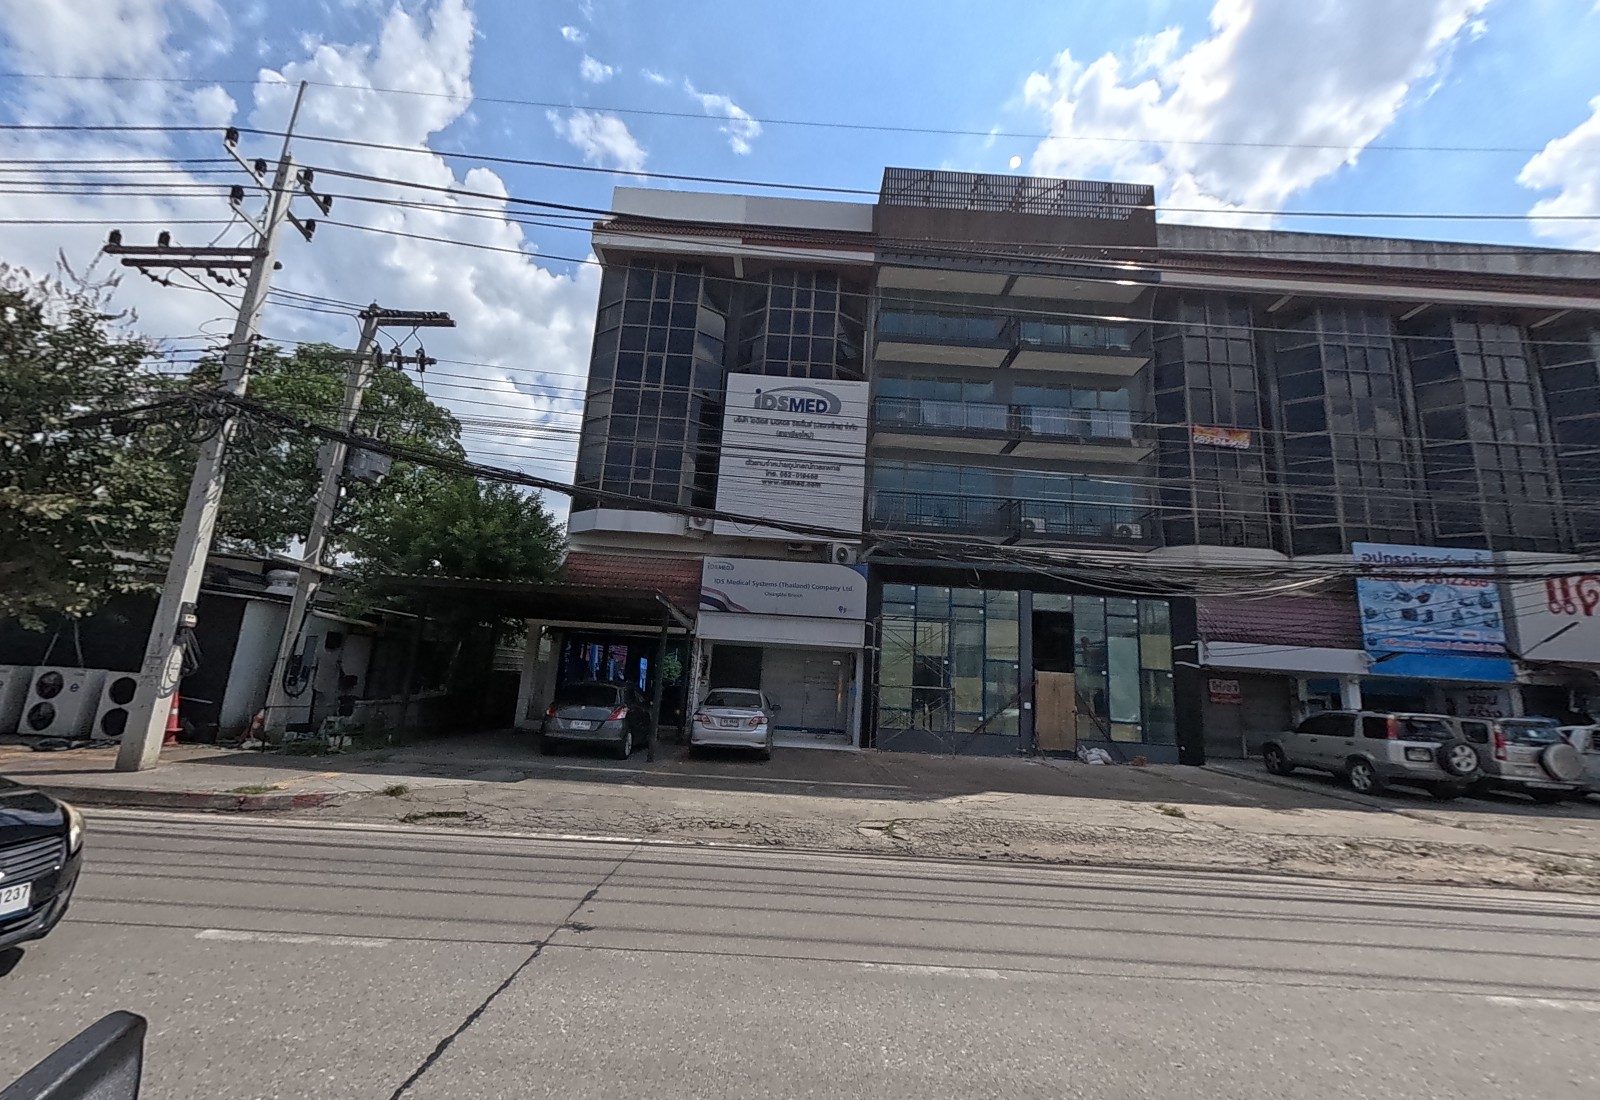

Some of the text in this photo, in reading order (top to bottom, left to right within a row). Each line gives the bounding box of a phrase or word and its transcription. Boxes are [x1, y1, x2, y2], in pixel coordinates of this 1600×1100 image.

[727, 578, 751, 587] Medical
[752, 580, 778, 589] Systems
[778, 581, 811, 590] (Thailand)
[812, 583, 841, 592] Company
